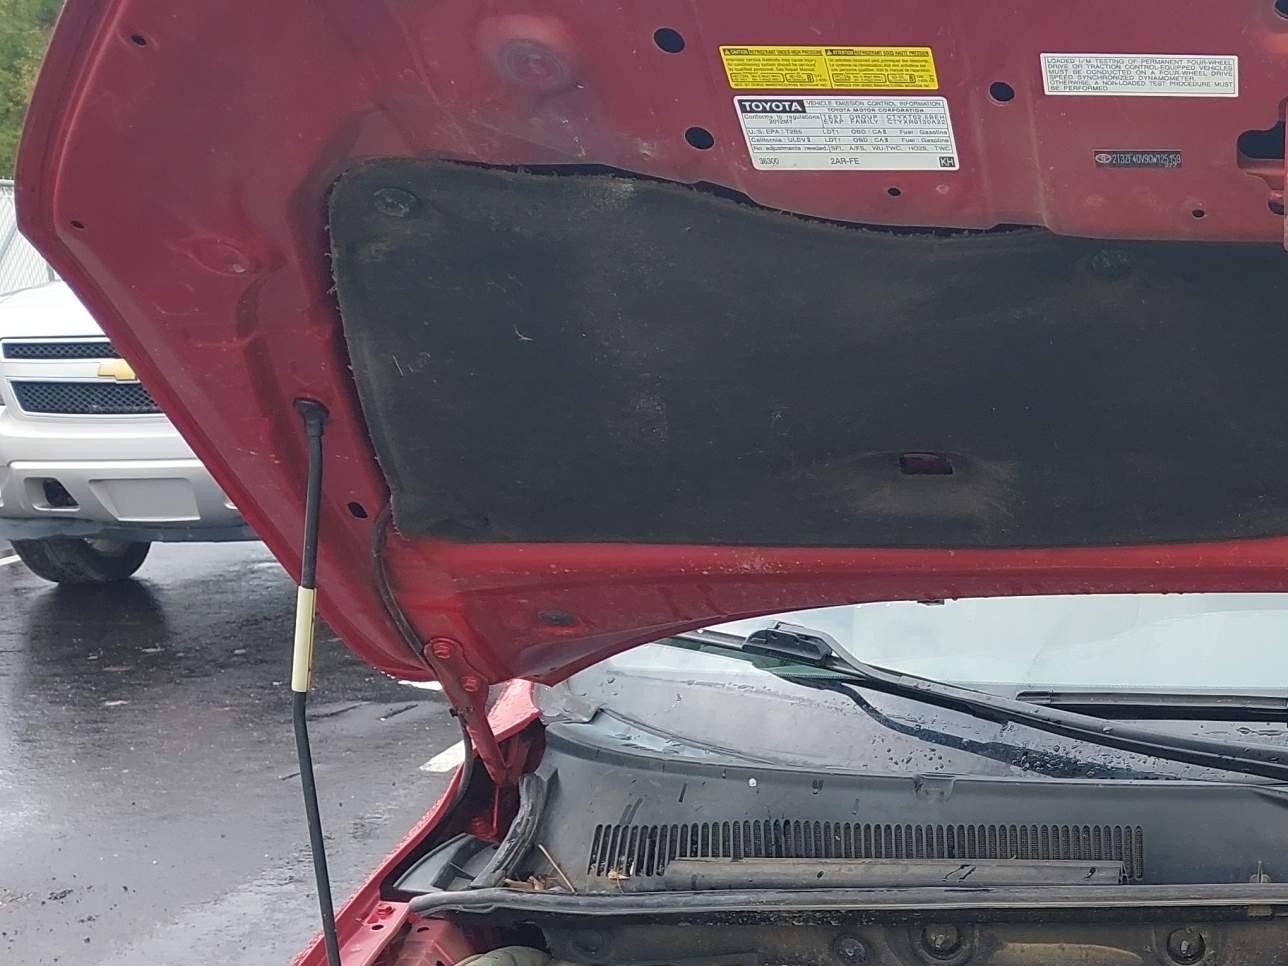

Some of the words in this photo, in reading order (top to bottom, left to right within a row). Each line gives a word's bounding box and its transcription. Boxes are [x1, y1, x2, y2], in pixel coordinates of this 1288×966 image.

[741, 102, 803, 112] TOYOTA
[830, 157, 861, 165] 2AR-FE
[940, 158, 955, 167] KH
